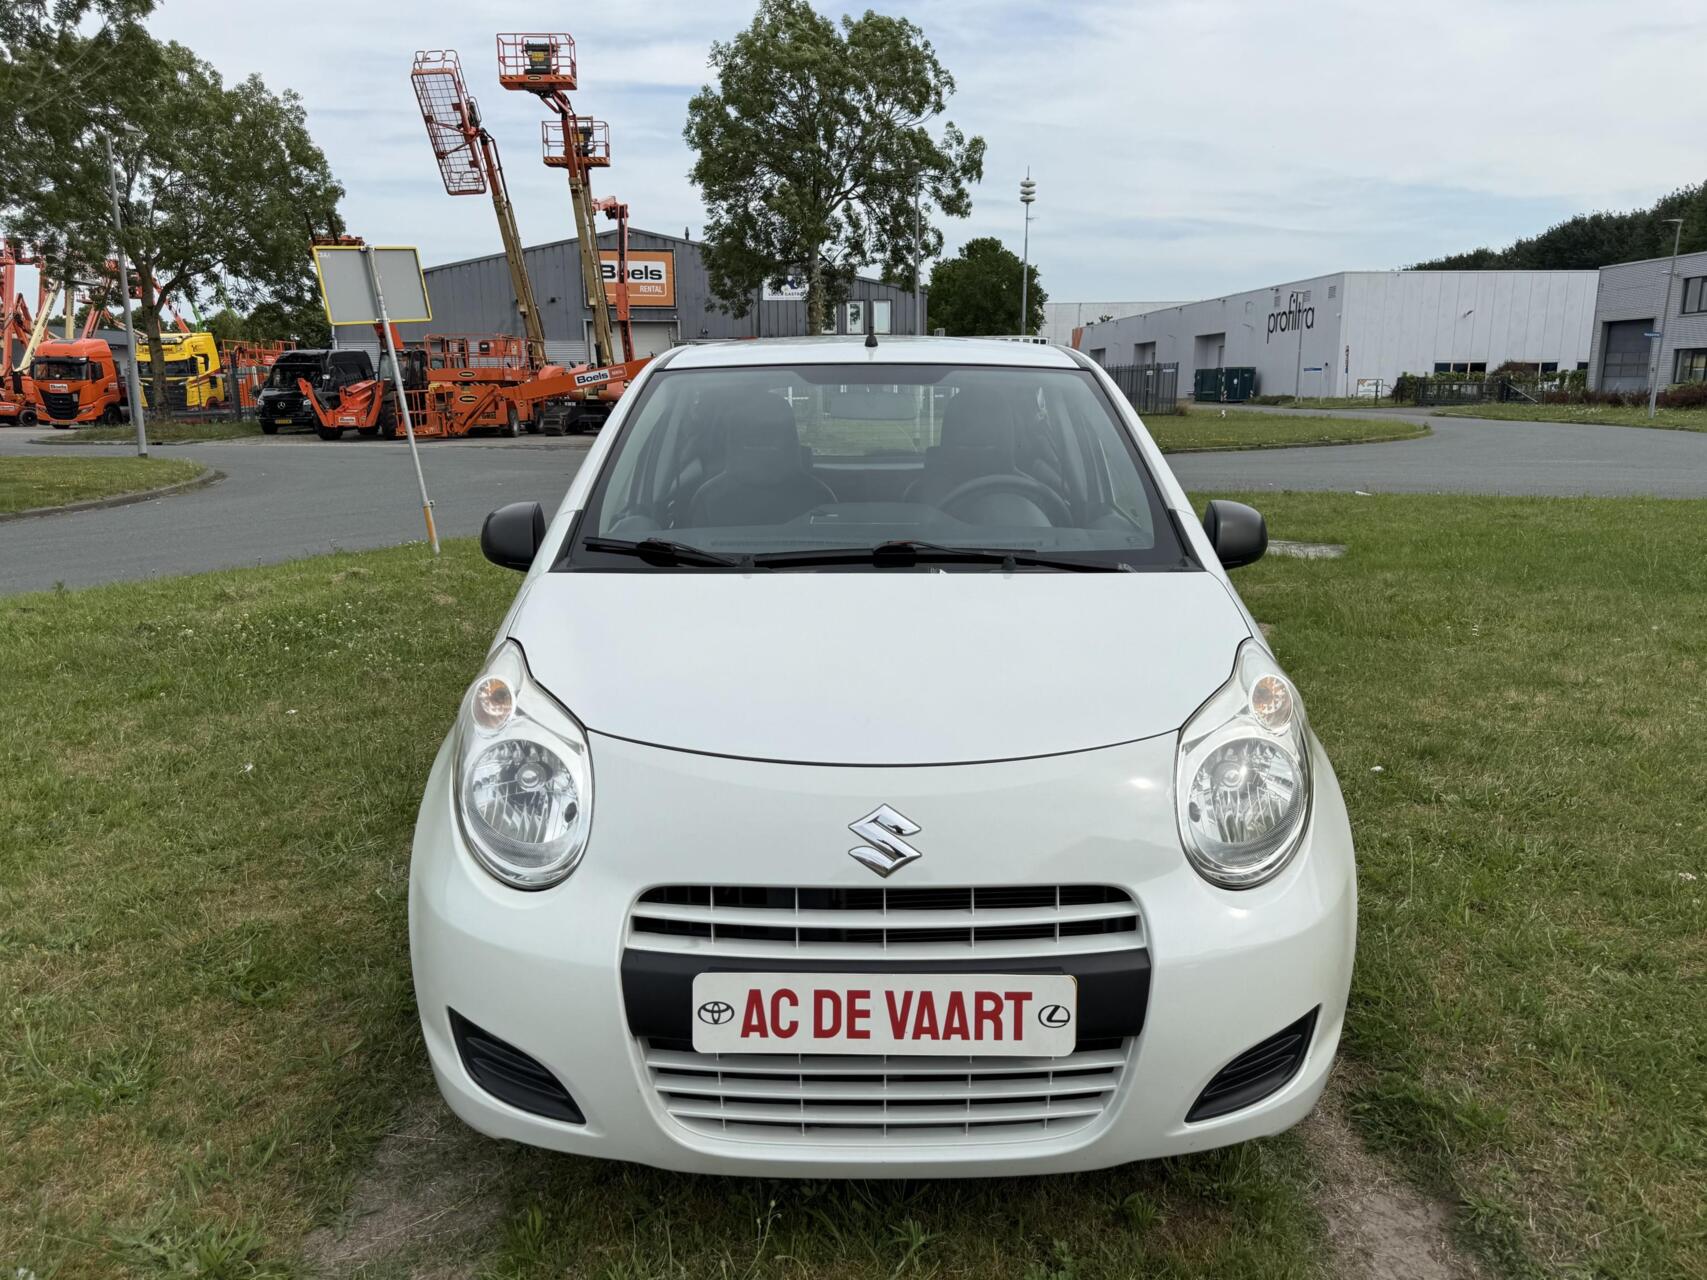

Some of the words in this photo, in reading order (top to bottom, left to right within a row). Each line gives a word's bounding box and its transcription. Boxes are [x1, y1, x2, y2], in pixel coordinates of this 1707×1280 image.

[601, 264, 663, 280] Bels
[640, 285, 663, 293] RENTAL
[1266, 292, 1315, 345] profiltra
[576, 372, 609, 384] Boels
[740, 988, 799, 1039] AC
[813, 989, 871, 1040] DE
[885, 990, 1033, 1041] VAART
